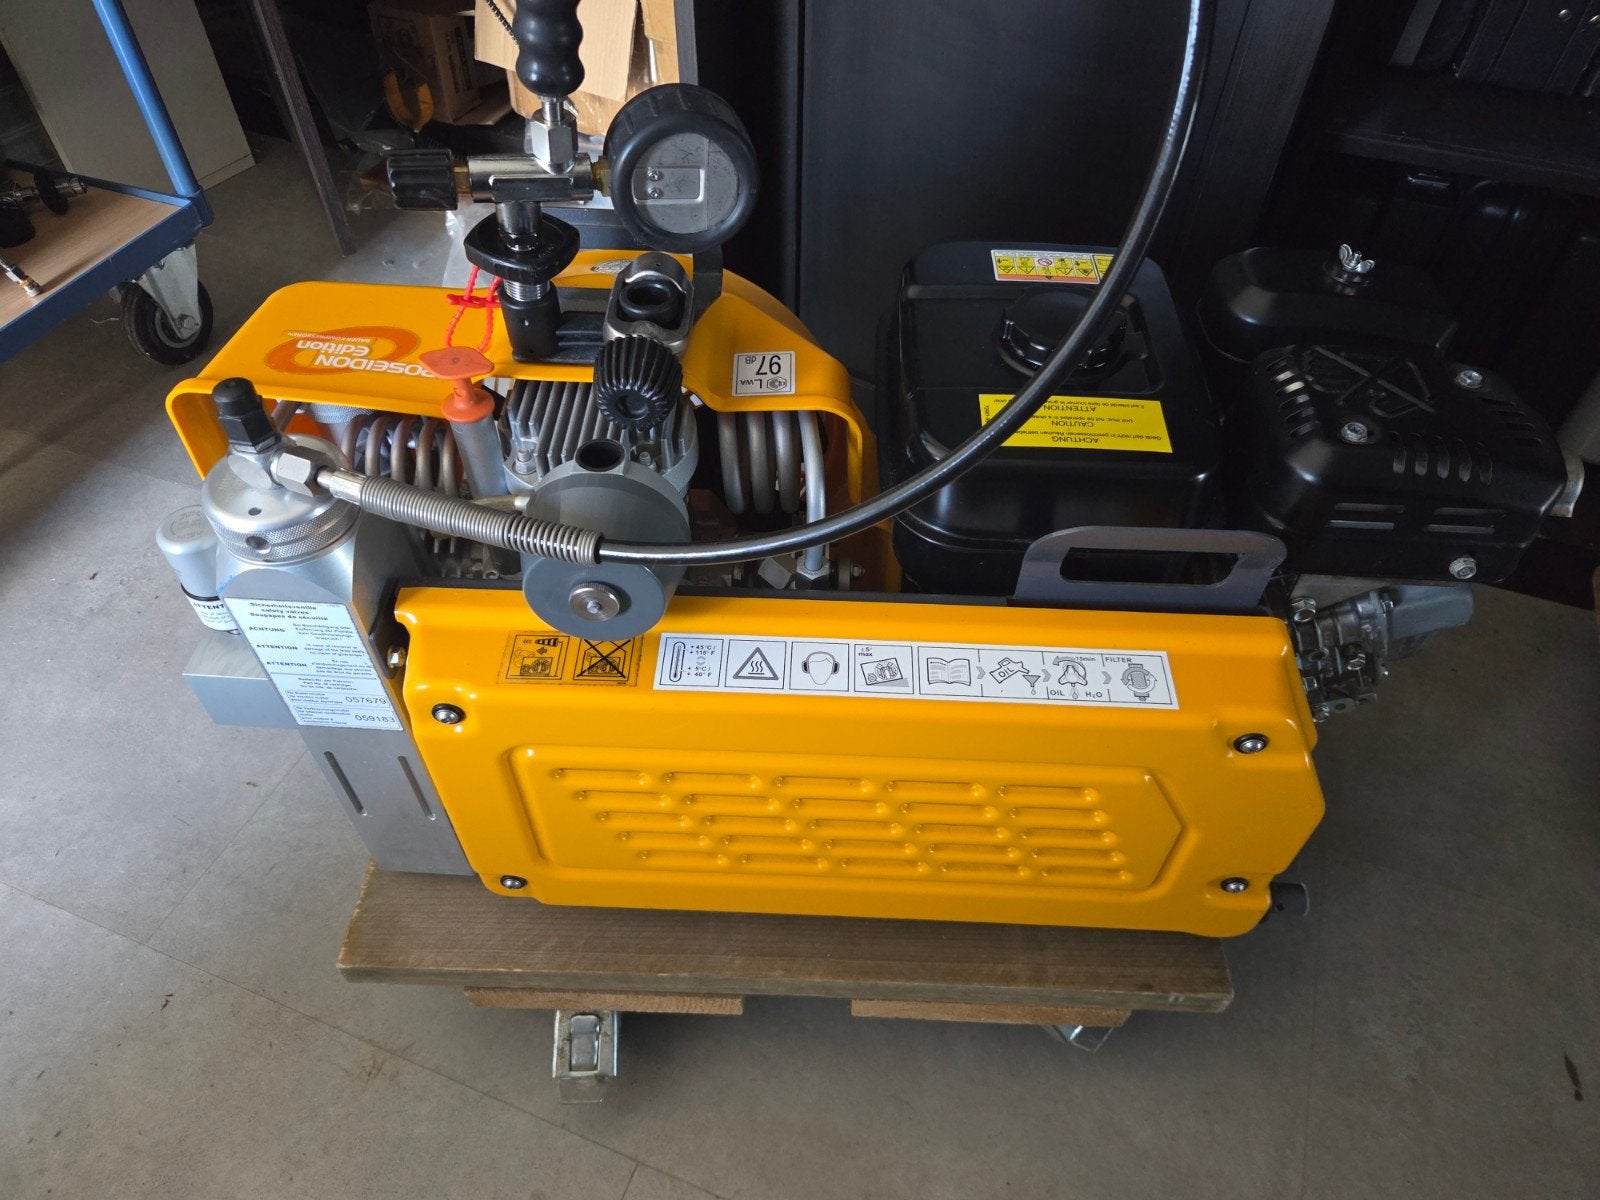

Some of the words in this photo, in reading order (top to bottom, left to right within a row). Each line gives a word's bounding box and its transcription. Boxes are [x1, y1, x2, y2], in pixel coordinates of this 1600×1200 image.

[287, 332, 347, 342] KOMPRESSOREN
[296, 340, 370, 357] Edition
[745, 356, 756, 365] dB
[755, 355, 781, 376] 97
[1051, 420, 1094, 428] CAUTION
[1051, 436, 1099, 444] ACHTUNG
[998, 666, 1015, 678] OIL
[1050, 689, 1065, 697] OIL
[345, 696, 387, 704] 057679
